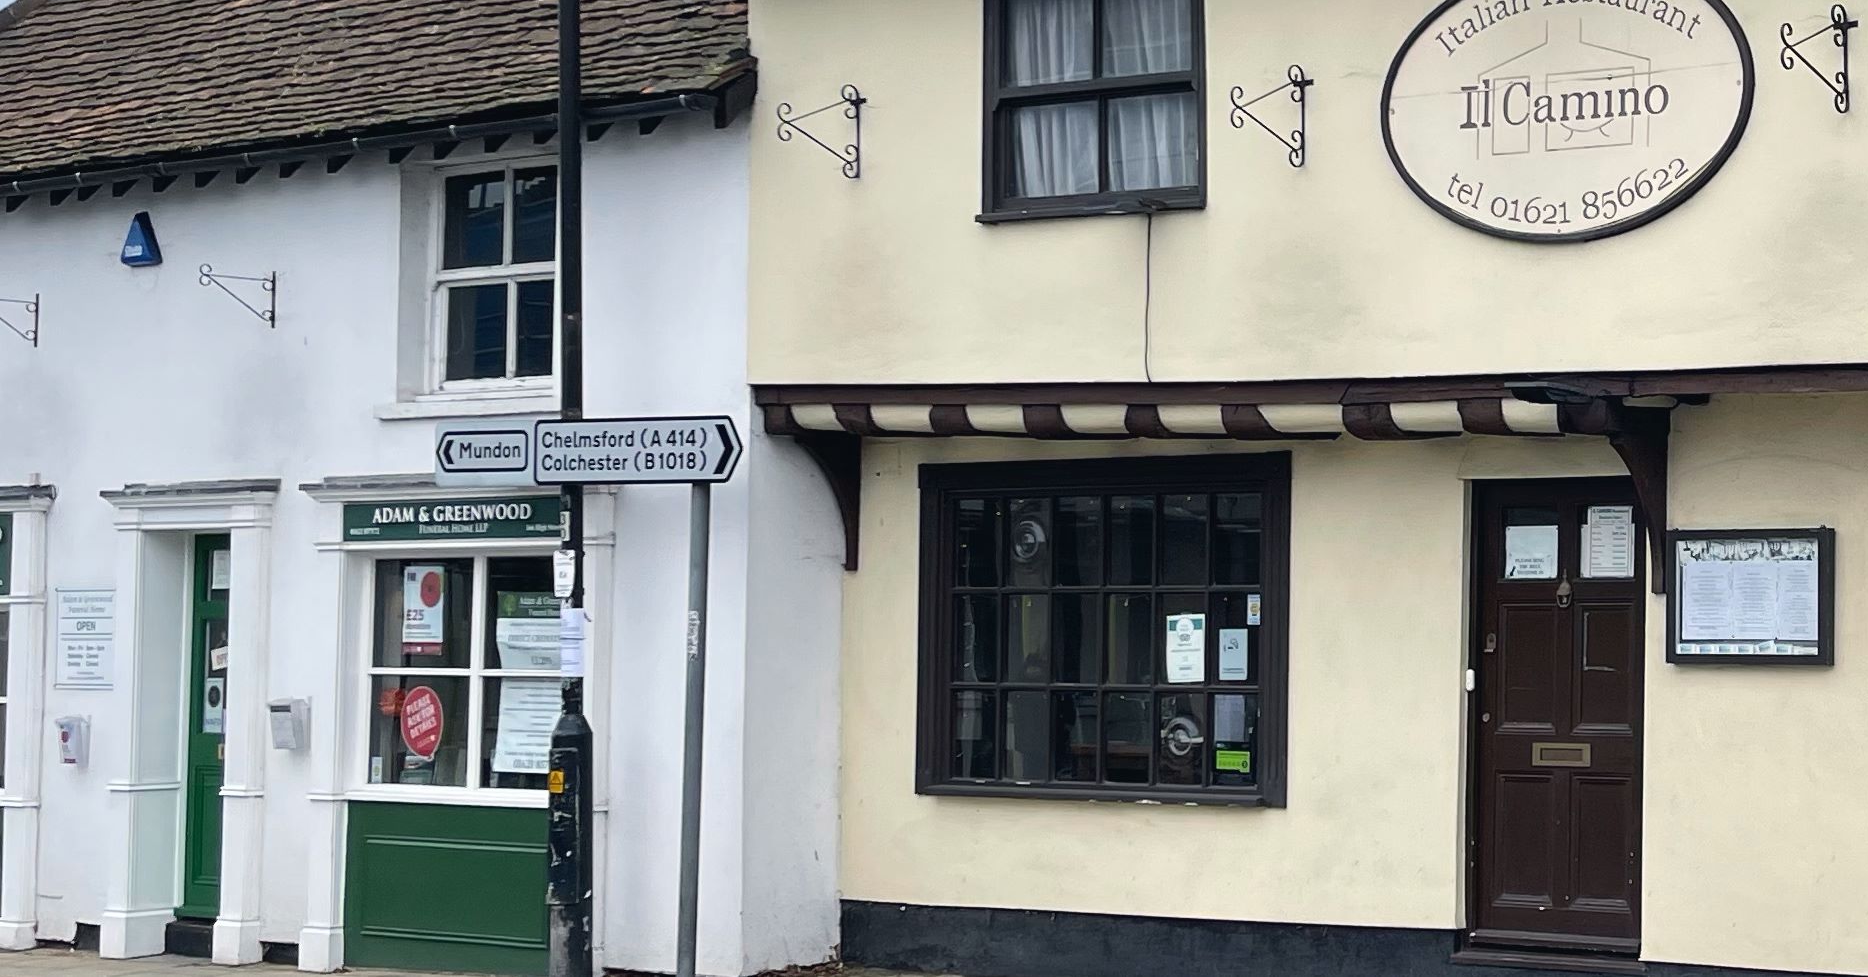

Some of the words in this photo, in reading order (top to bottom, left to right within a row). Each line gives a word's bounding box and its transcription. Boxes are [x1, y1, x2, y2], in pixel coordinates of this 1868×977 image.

[1459, 78, 1492, 130] Il
[1503, 80, 1671, 126] Camino
[1447, 172, 1483, 210] tel
[1491, 195, 1571, 225] 01621
[1582, 157, 1690, 220] 856622
[541, 429, 635, 449] Chelmsford
[459, 441, 521, 459] Mundon
[541, 453, 628, 472] Colchester
[372, 506, 415, 524] ADAM
[418, 505, 430, 523] &
[432, 503, 532, 523] GREENWOOD
[406, 608, 425, 621] £25
[76, 620, 96, 632] OPEN
